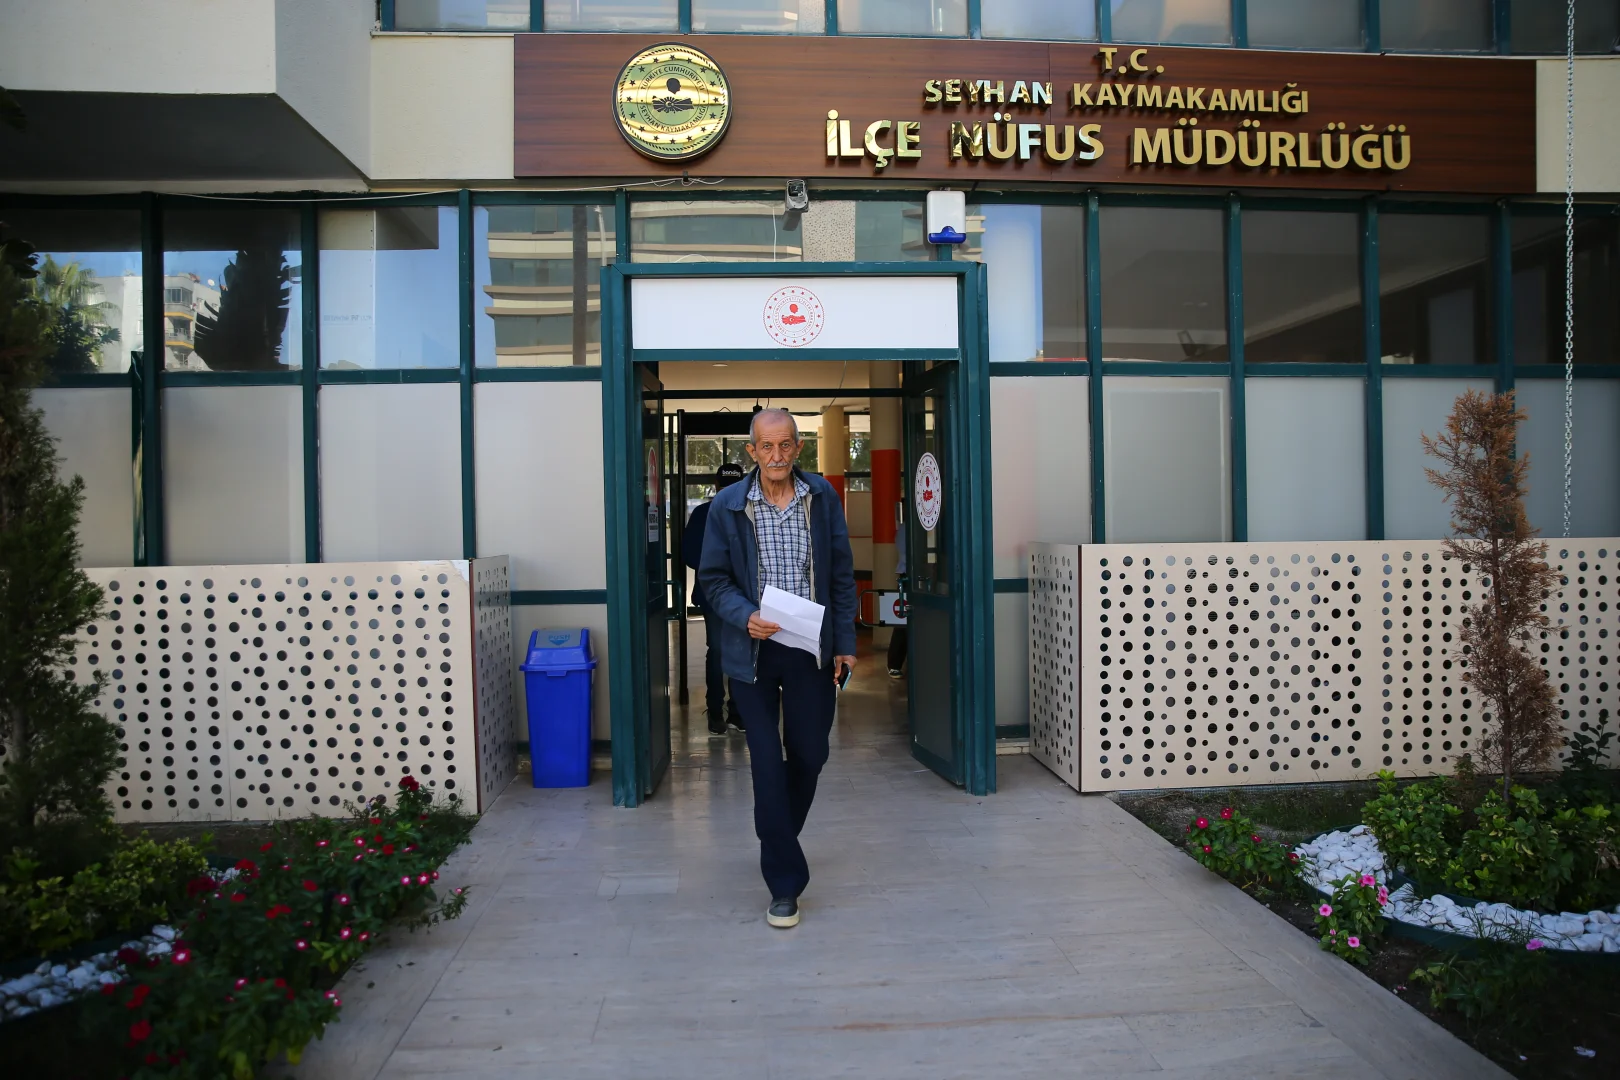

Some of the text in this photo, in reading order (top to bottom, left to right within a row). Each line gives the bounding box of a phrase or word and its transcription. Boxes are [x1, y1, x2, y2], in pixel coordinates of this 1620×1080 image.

[925, 79, 1309, 113] SEYHAN KAYMAKAMLIĞI
[826, 109, 1411, 170] İLÇE NÜFUS MÜDÜRLÜĞÜ
[548, 633, 571, 641] PUSH
